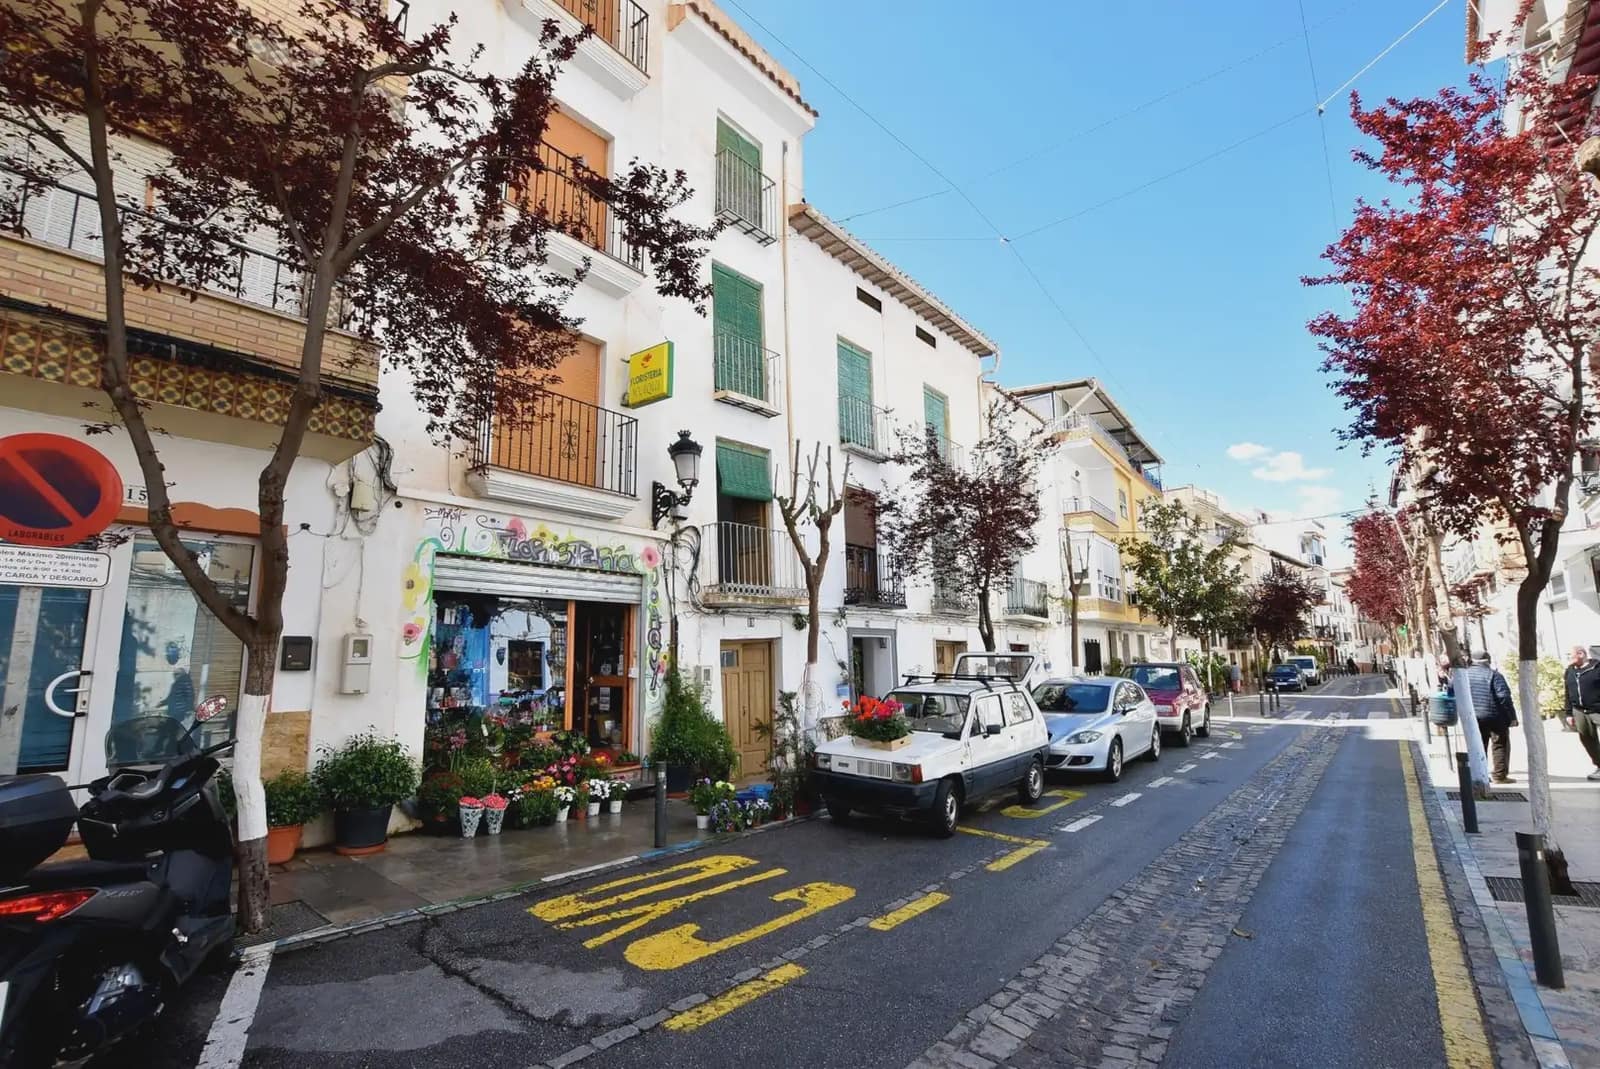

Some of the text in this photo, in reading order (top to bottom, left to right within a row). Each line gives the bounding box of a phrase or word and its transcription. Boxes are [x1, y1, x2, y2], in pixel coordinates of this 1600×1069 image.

[8, 529, 65, 541] LABORABLES
[5, 571, 39, 579] CARGA
[49, 574, 98, 583] DESCARGA
